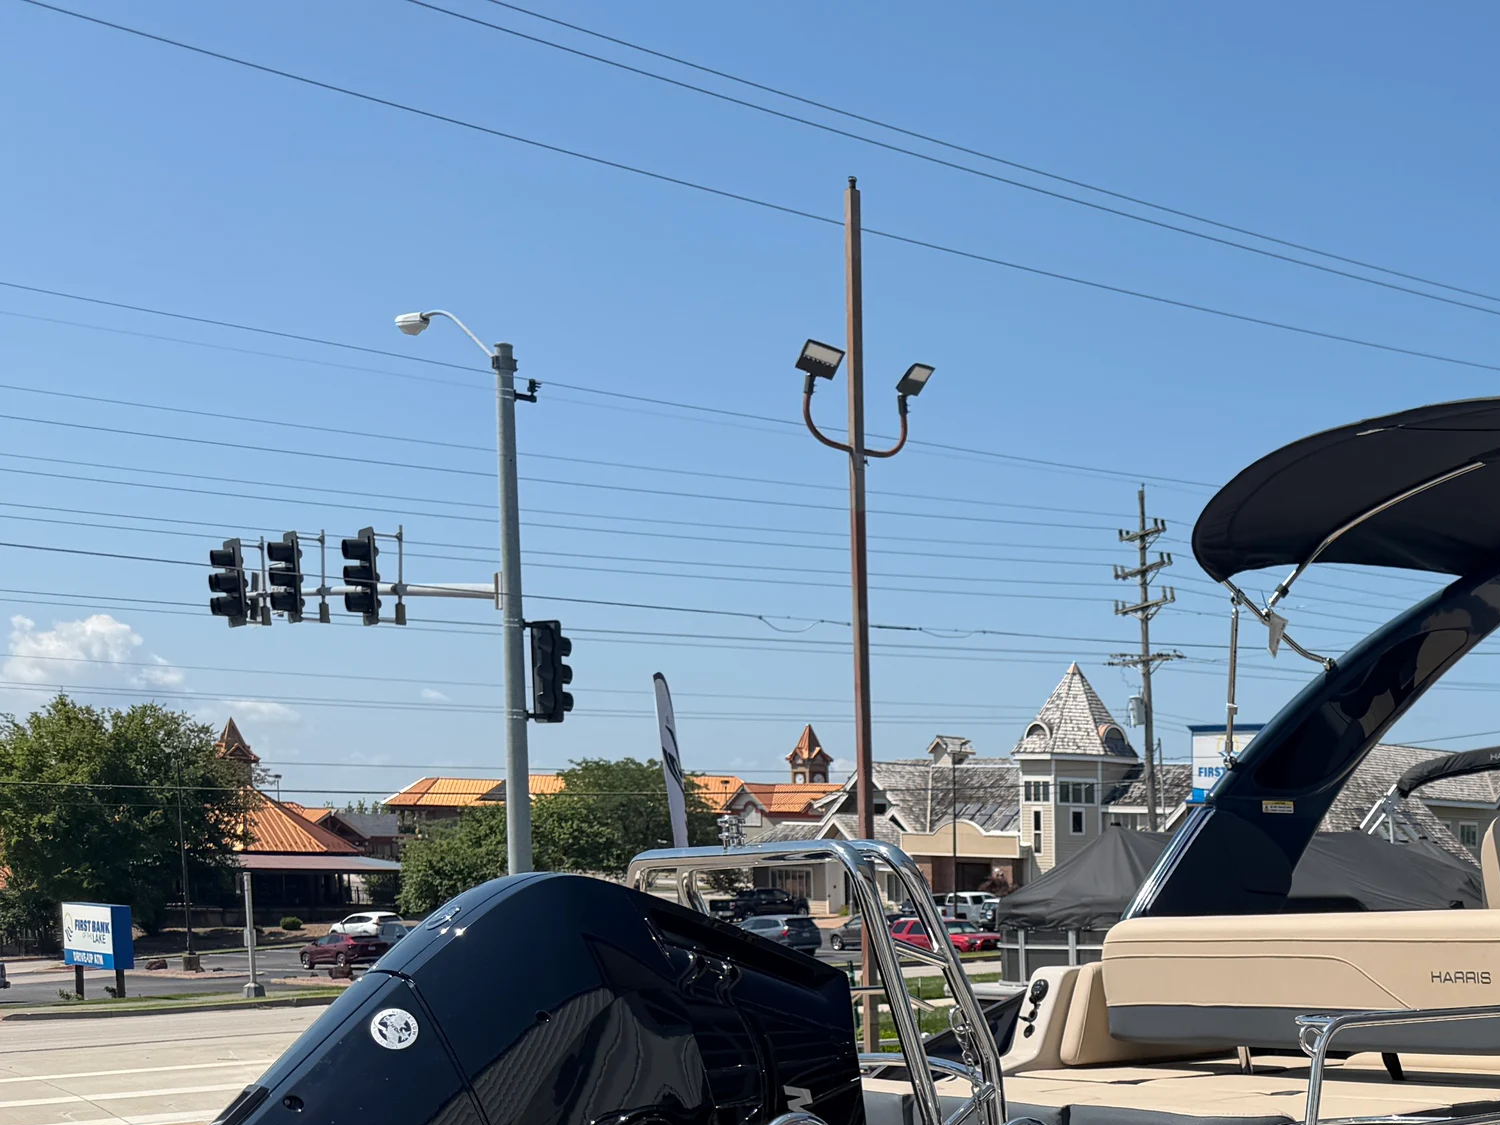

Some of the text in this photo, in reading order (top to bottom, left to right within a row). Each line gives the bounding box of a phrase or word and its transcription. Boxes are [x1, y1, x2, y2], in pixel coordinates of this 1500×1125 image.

[1198, 767, 1227, 778] FIRST
[75, 919, 110, 934] FIRST BANK
[93, 933, 106, 944] LAKE
[1431, 971, 1491, 984] HARRIS
